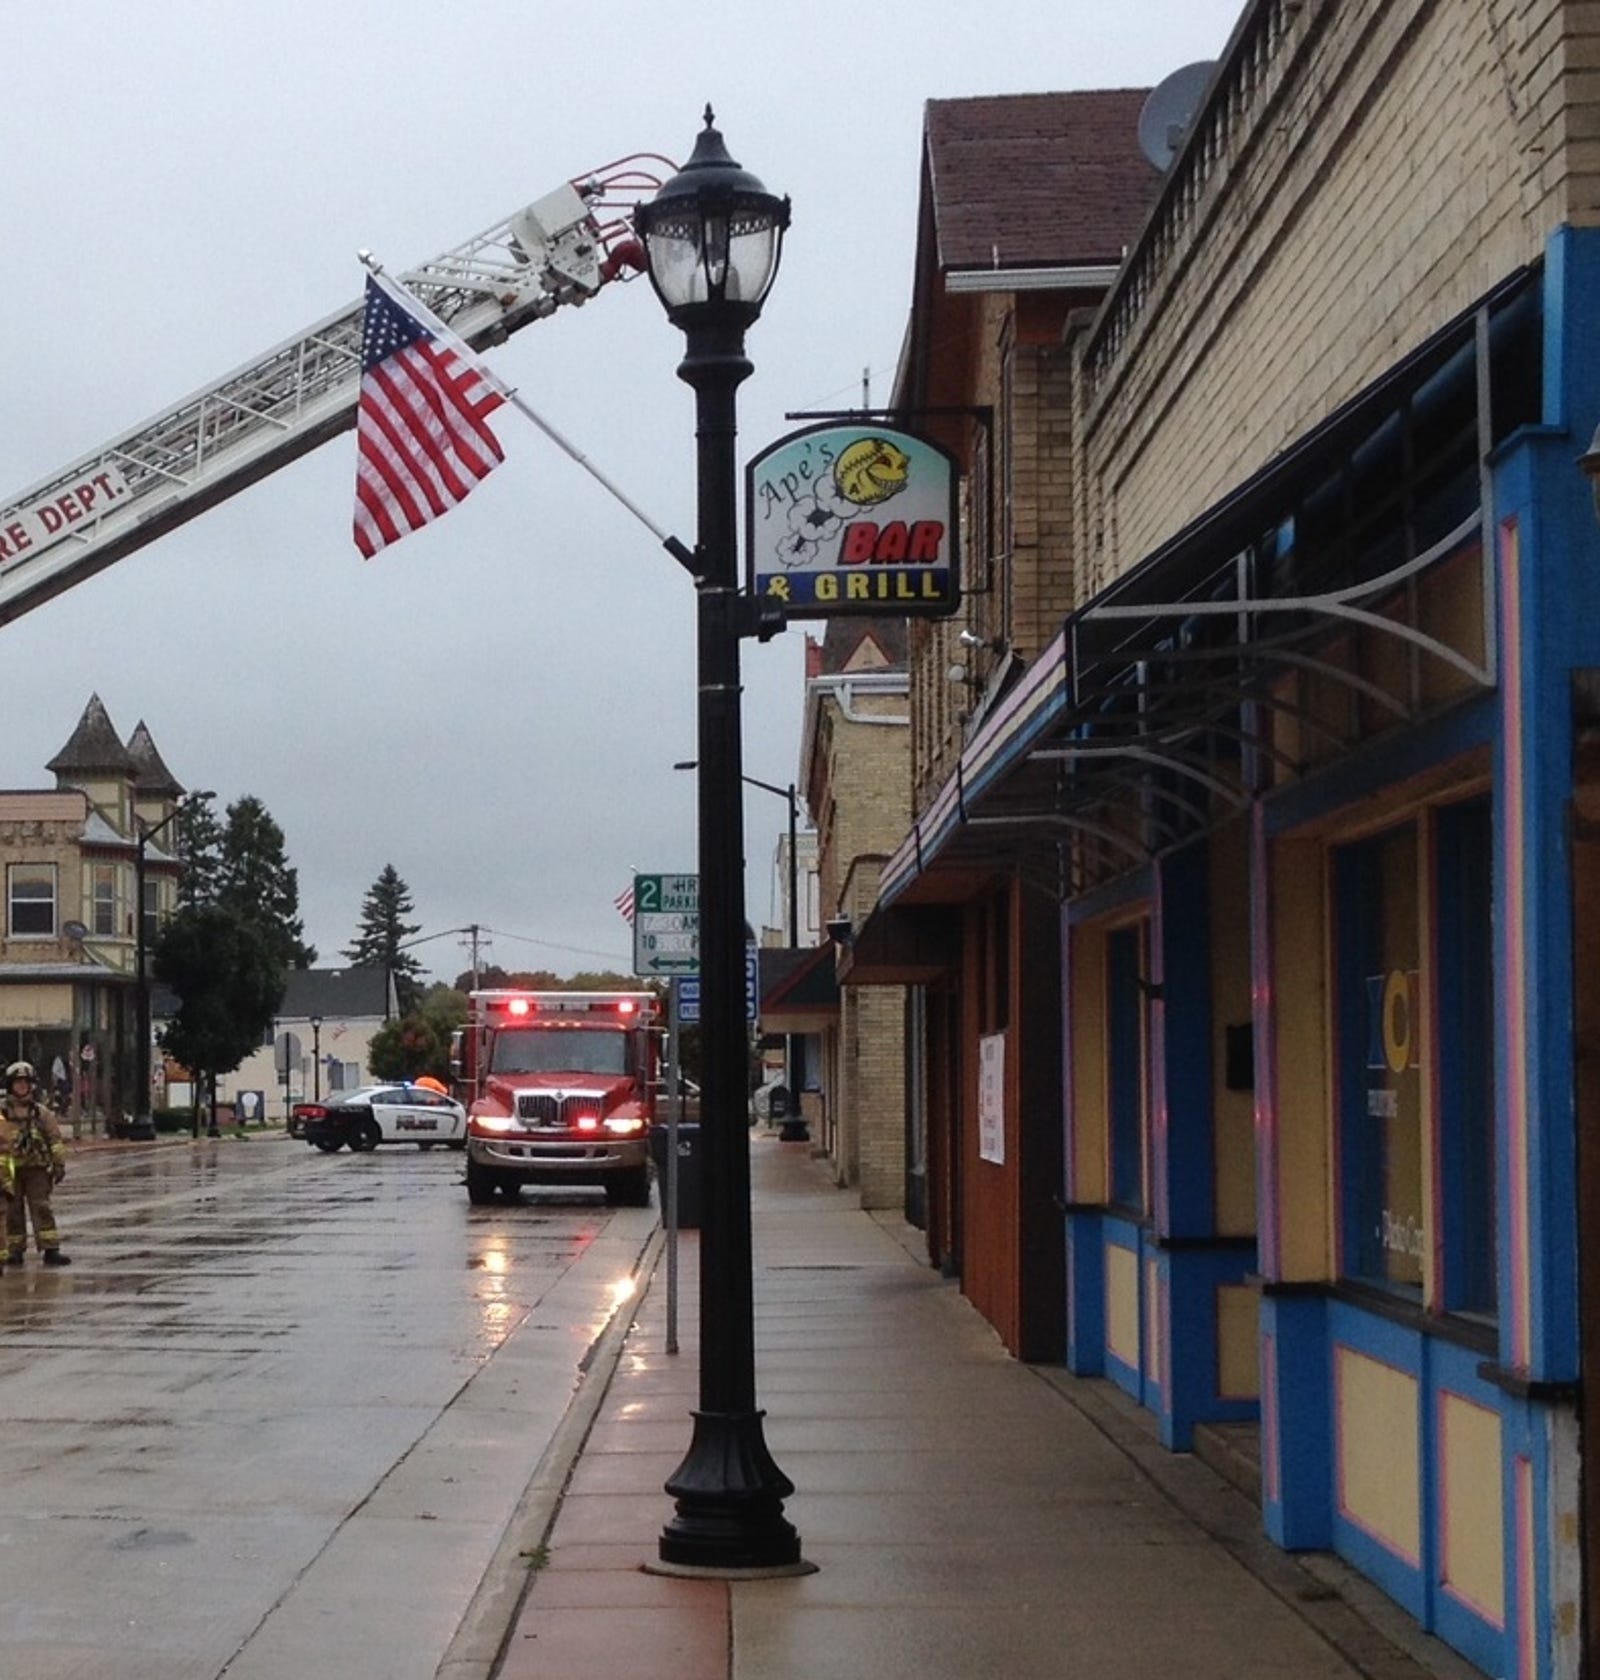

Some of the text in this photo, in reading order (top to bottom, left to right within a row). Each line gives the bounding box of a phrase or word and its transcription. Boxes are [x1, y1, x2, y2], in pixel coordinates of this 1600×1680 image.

[760, 442, 834, 519] Ape's
[37, 472, 124, 534] DEPT.
[837, 521, 944, 566] BAR
[767, 572, 941, 600] & GRILL
[640, 879, 658, 909] 2
[665, 895, 696, 909] PARKI
